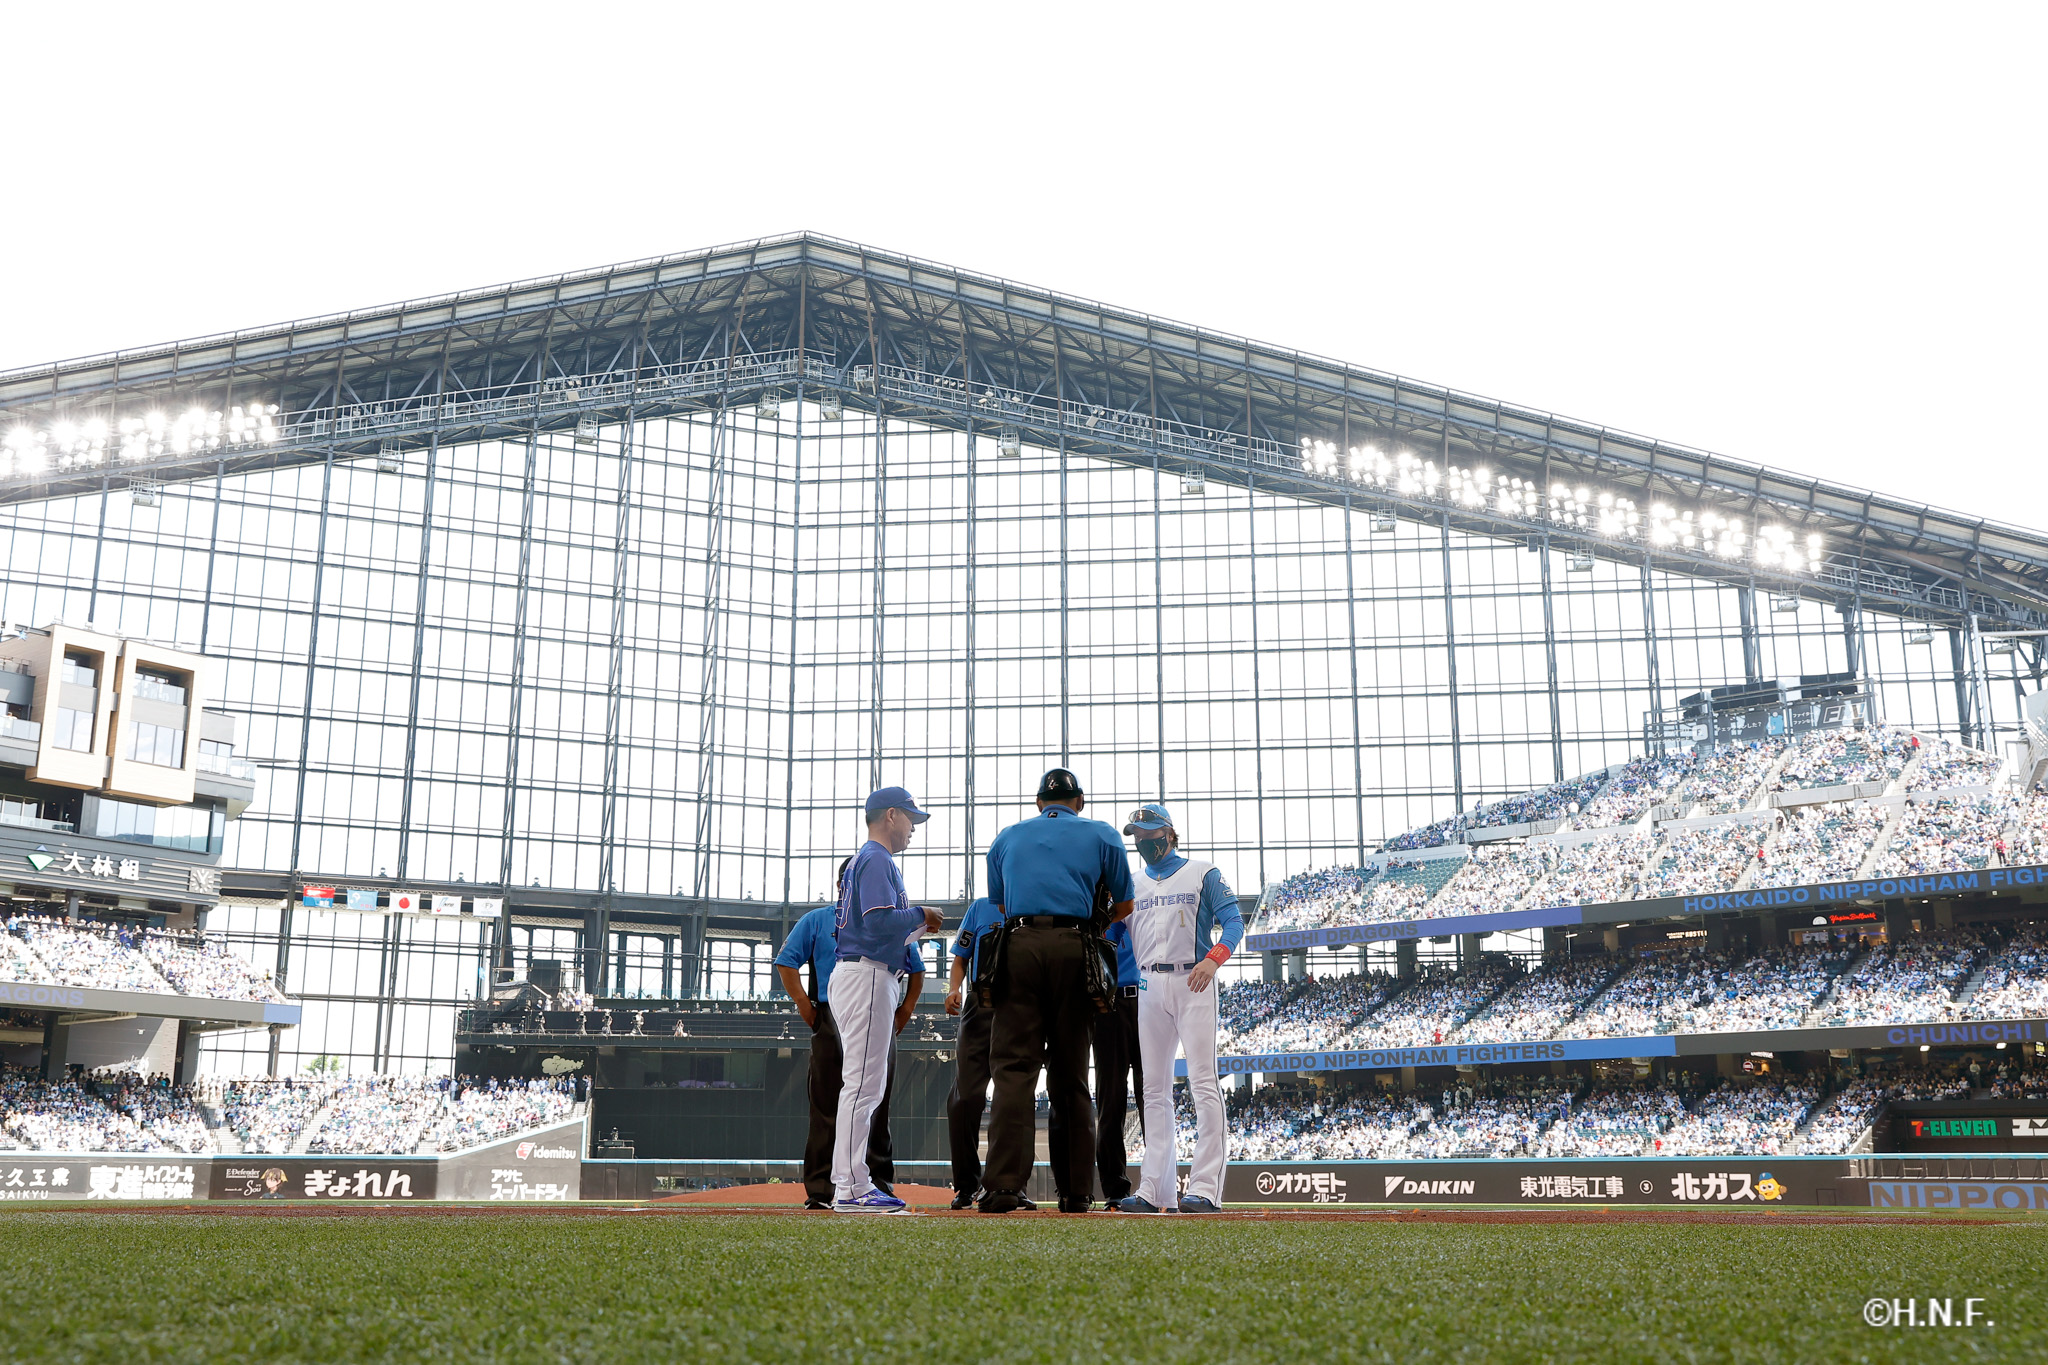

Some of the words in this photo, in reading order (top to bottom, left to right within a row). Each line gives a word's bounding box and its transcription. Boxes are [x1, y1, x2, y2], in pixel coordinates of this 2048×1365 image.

[62, 852, 139, 880] 大林組
[1134, 892, 1197, 912] IGHTERS
[1684, 888, 1809, 912] HOKKAIDO
[1819, 873, 1979, 900] NIPPONHAM
[1177, 909, 1186, 928] 1
[1325, 922, 1419, 942] DRAGONS
[1887, 1023, 2032, 1044] CHUNICHI
[1218, 1055, 1317, 1073] HOKKAIDO
[1324, 1049, 1448, 1070] NIPPONHAM
[1457, 1043, 1565, 1062] FIGHTERS
[533, 1145, 577, 1159] idemitsu
[0, 1167, 71, 1187] 久工業
[86, 1164, 143, 1200] 東進
[304, 1169, 414, 1197] ぎょれん
[491, 1169, 523, 1183] アサヒ
[1276, 1172, 1347, 1193] オカモト
[489, 1183, 569, 1200] スーパードライ
[1402, 1180, 1475, 1194] DAIKIN
[1520, 1175, 1624, 1198] 東光電気工事
[1671, 1172, 1757, 1201] 北ガス
[1312, 1193, 1347, 1203] グループ
